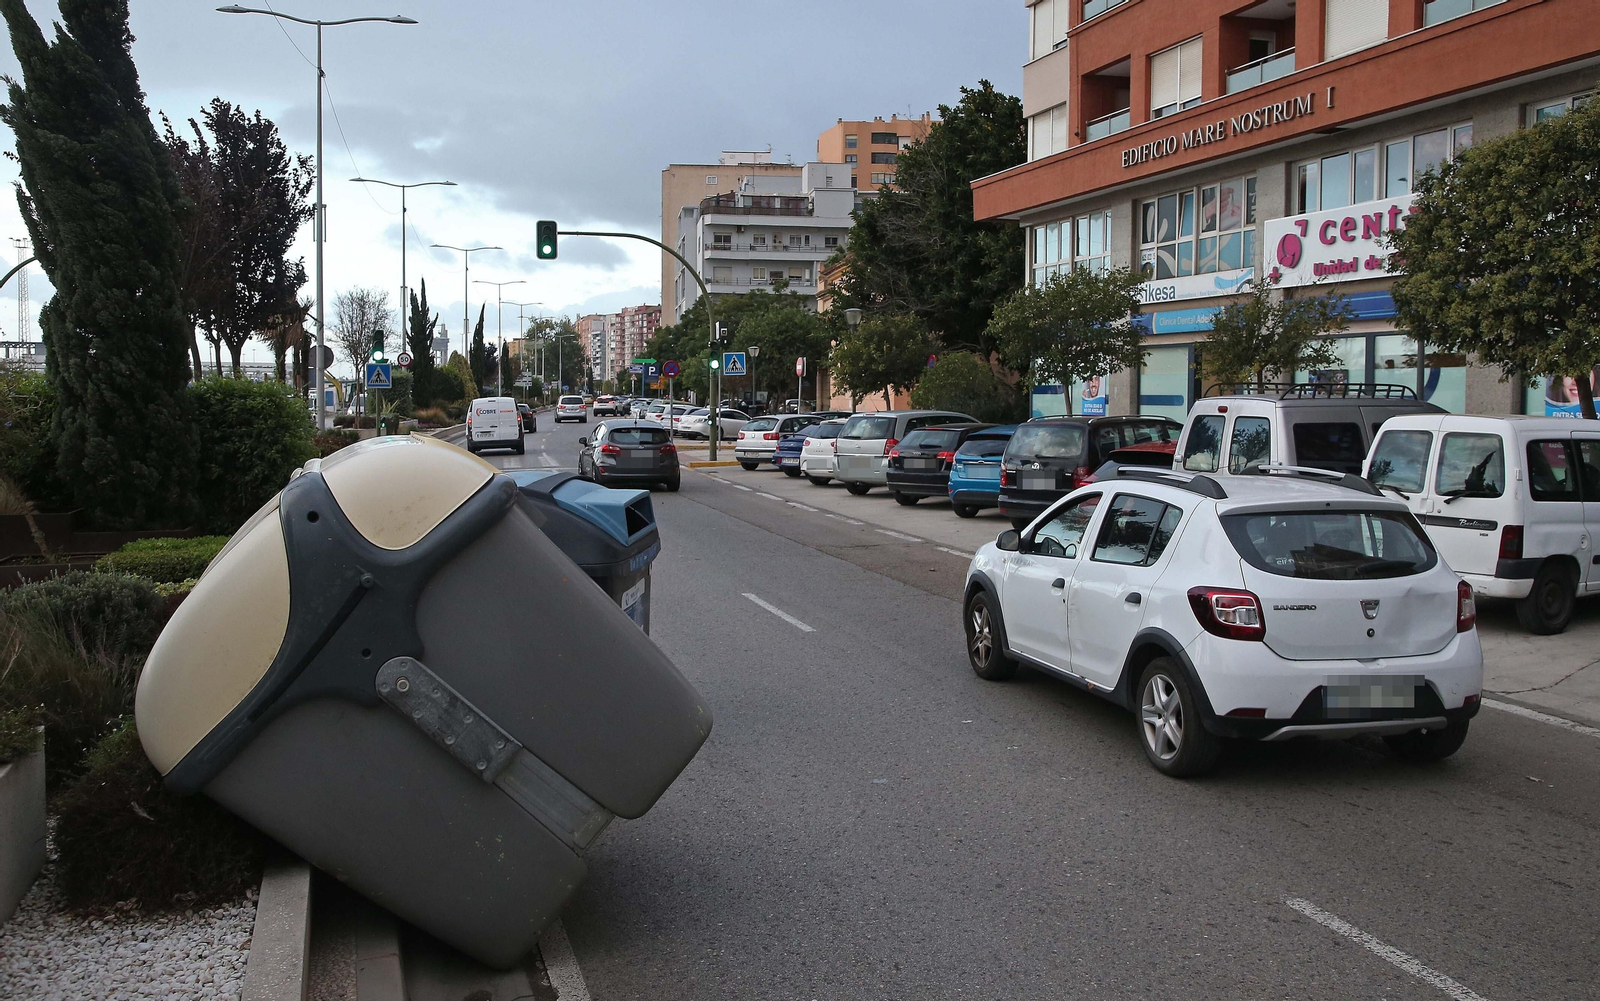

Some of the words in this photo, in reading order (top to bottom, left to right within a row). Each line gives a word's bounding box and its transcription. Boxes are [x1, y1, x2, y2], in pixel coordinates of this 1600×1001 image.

[1121, 135, 1177, 168] EDIFICIO
[1181, 121, 1225, 150] MARE
[1230, 92, 1315, 136] NOSTRUM
[1326, 86, 1335, 108] I
[1313, 257, 1359, 276] Unidad
[1364, 255, 1382, 270] de
[1140, 283, 1176, 302] ikesa
[1177, 315, 1195, 325] Dental
[648, 366, 656, 376] P
[1459, 518, 1490, 528] Berlingo
